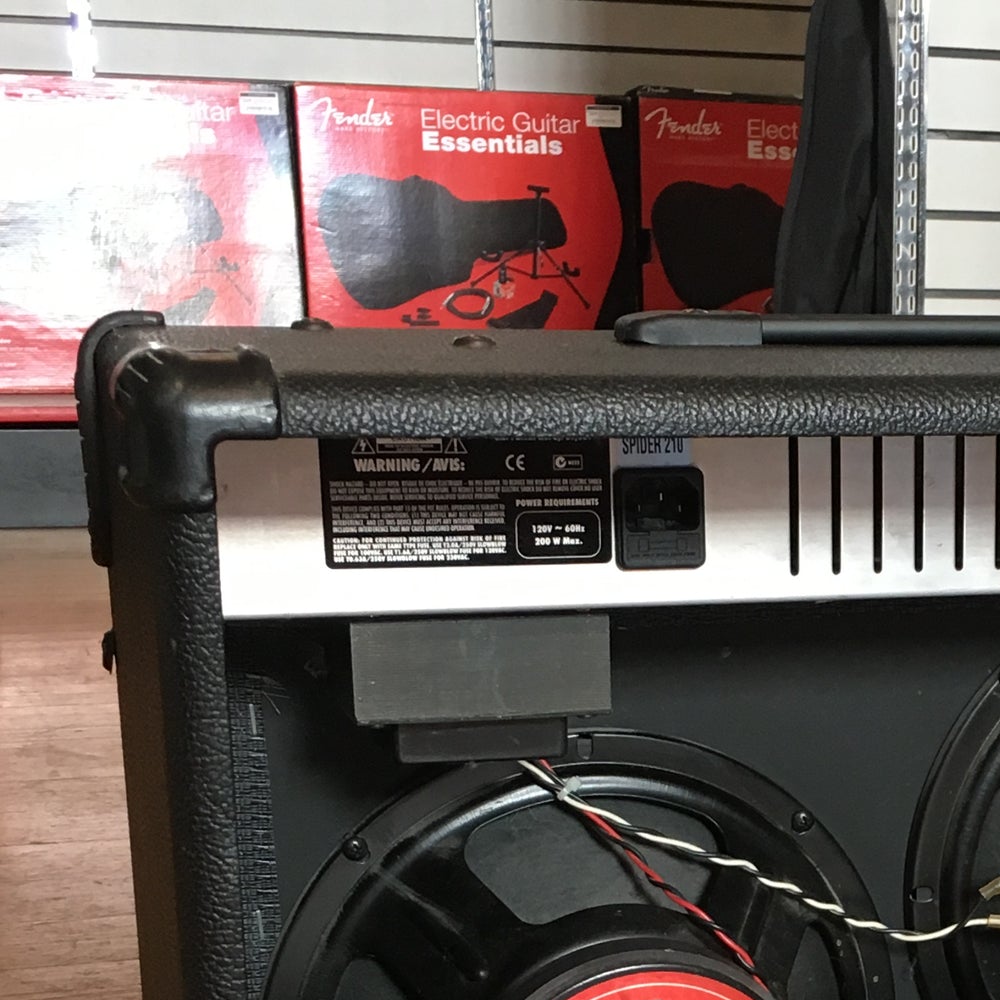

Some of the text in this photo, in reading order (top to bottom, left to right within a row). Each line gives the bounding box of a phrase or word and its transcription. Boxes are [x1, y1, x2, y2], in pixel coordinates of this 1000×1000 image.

[310, 97, 394, 132] Fender
[421, 108, 505, 132] Electric
[512, 112, 580, 134] Guitar
[644, 107, 722, 139] Fender
[421, 131, 563, 156] Essentials
[622, 437, 660, 454] SPIDER
[515, 498, 599, 507] POWER REQUIREMENTS
[532, 525, 552, 533] 120V
[565, 525, 585, 533] 60Hz
[535, 537, 550, 545] 200
[553, 537, 561, 545] W
